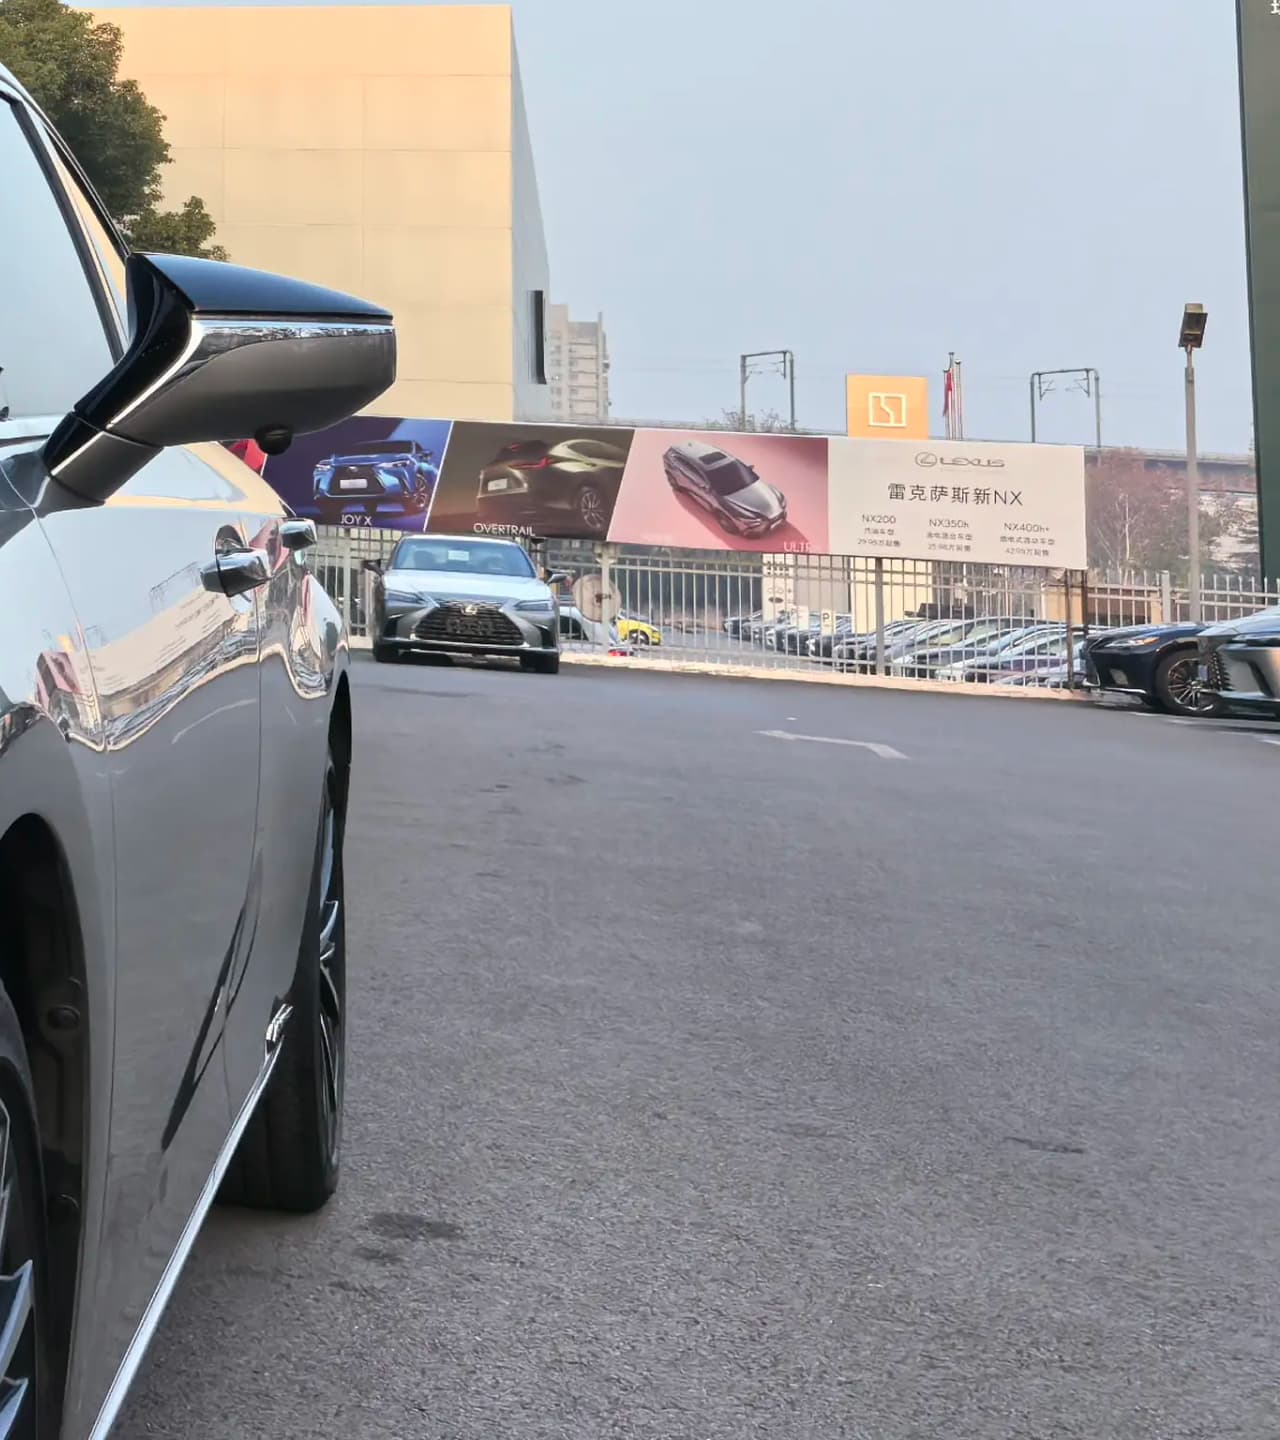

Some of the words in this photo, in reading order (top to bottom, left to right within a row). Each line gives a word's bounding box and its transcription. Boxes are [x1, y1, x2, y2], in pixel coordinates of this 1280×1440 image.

[939, 456, 1006, 468] LEXUS
[887, 482, 1023, 506] 雷克萨斯新NX
[340, 514, 362, 525] JOY
[363, 516, 373, 526] X
[861, 513, 897, 525] NX200
[928, 518, 970, 529] NX350h
[473, 522, 536, 537] OVERTRAIL
